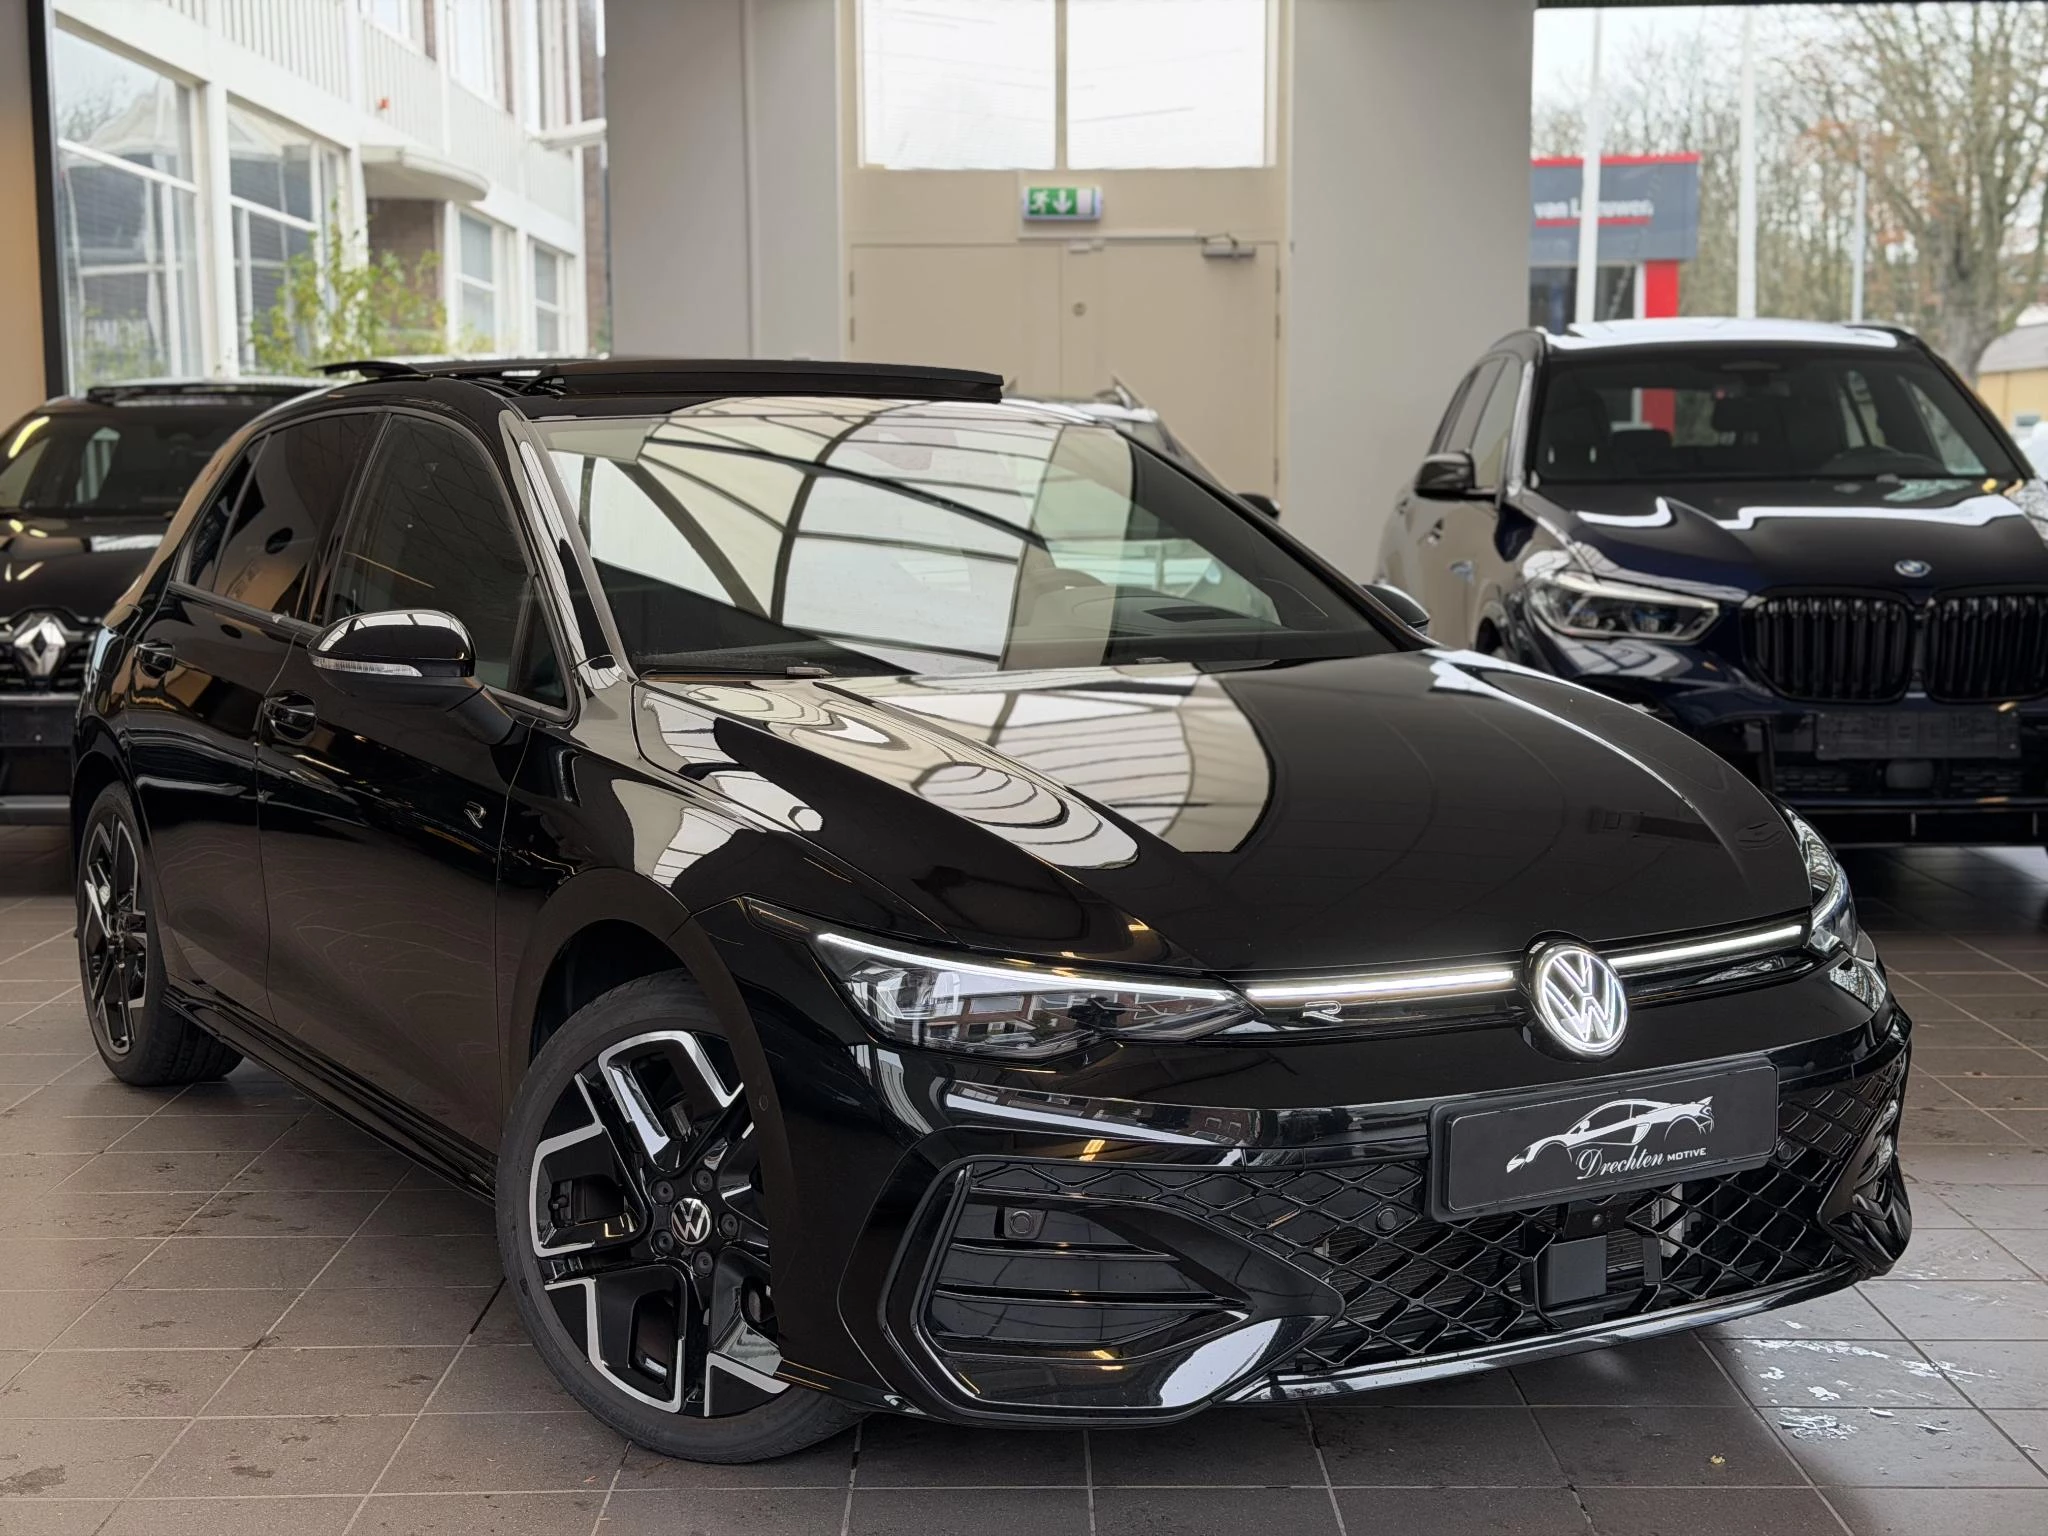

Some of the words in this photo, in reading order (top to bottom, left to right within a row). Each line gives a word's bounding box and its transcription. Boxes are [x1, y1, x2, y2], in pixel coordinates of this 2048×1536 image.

[1540, 950, 1625, 1048] VW
[1576, 1145, 1664, 1180] Drechten
[1667, 1147, 1707, 1162] MOTIVE
[672, 1198, 710, 1244] VW
